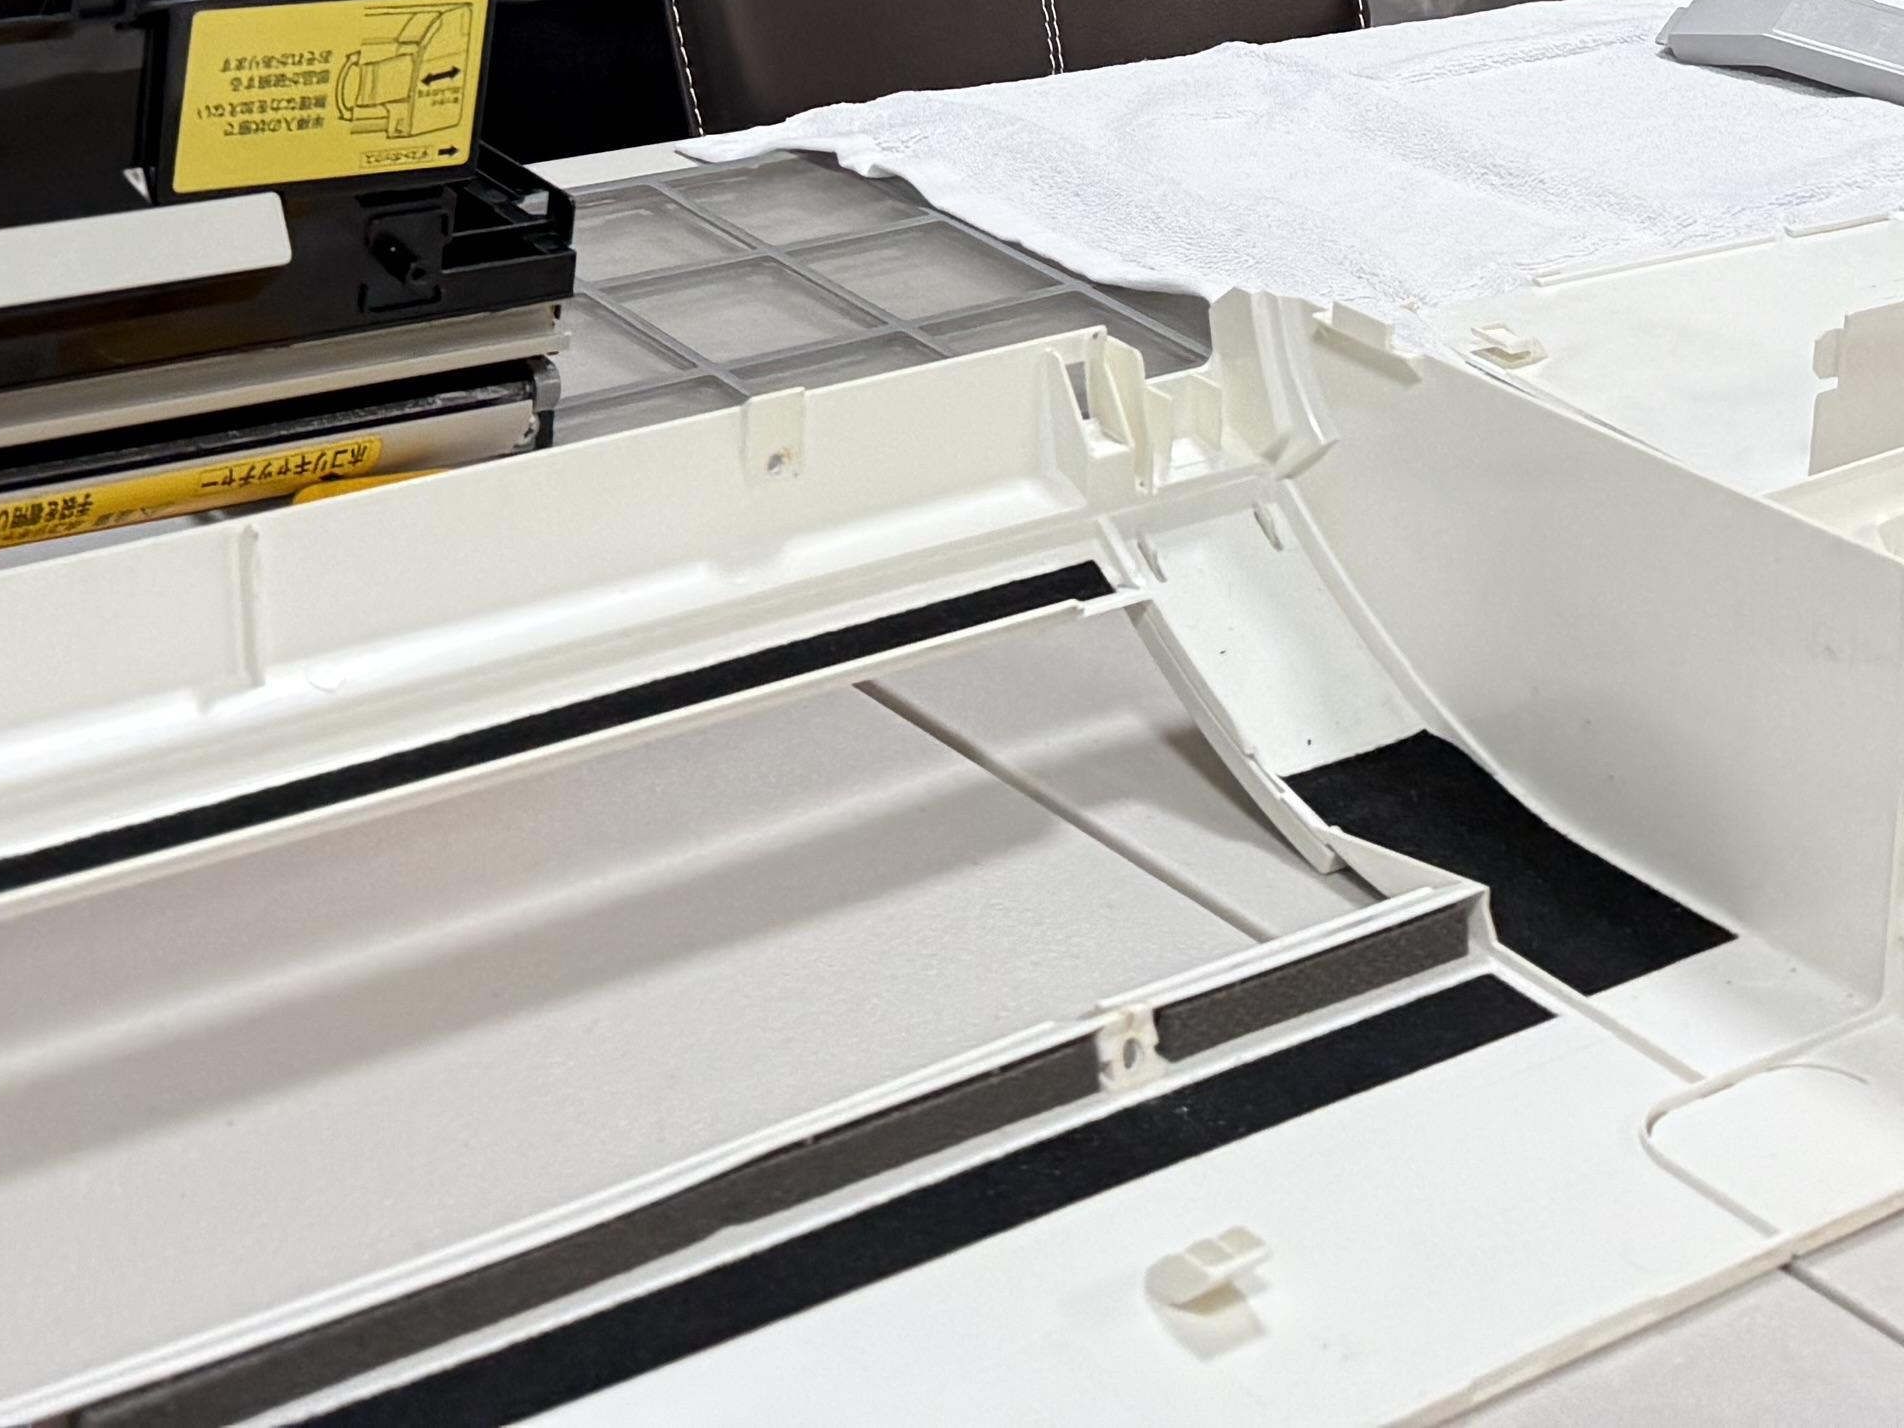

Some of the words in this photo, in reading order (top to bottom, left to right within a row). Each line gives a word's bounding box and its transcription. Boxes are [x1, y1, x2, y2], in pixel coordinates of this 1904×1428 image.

[221, 49, 333, 73] おそれがあります
[200, 444, 367, 491] ホコリキャッチャー
